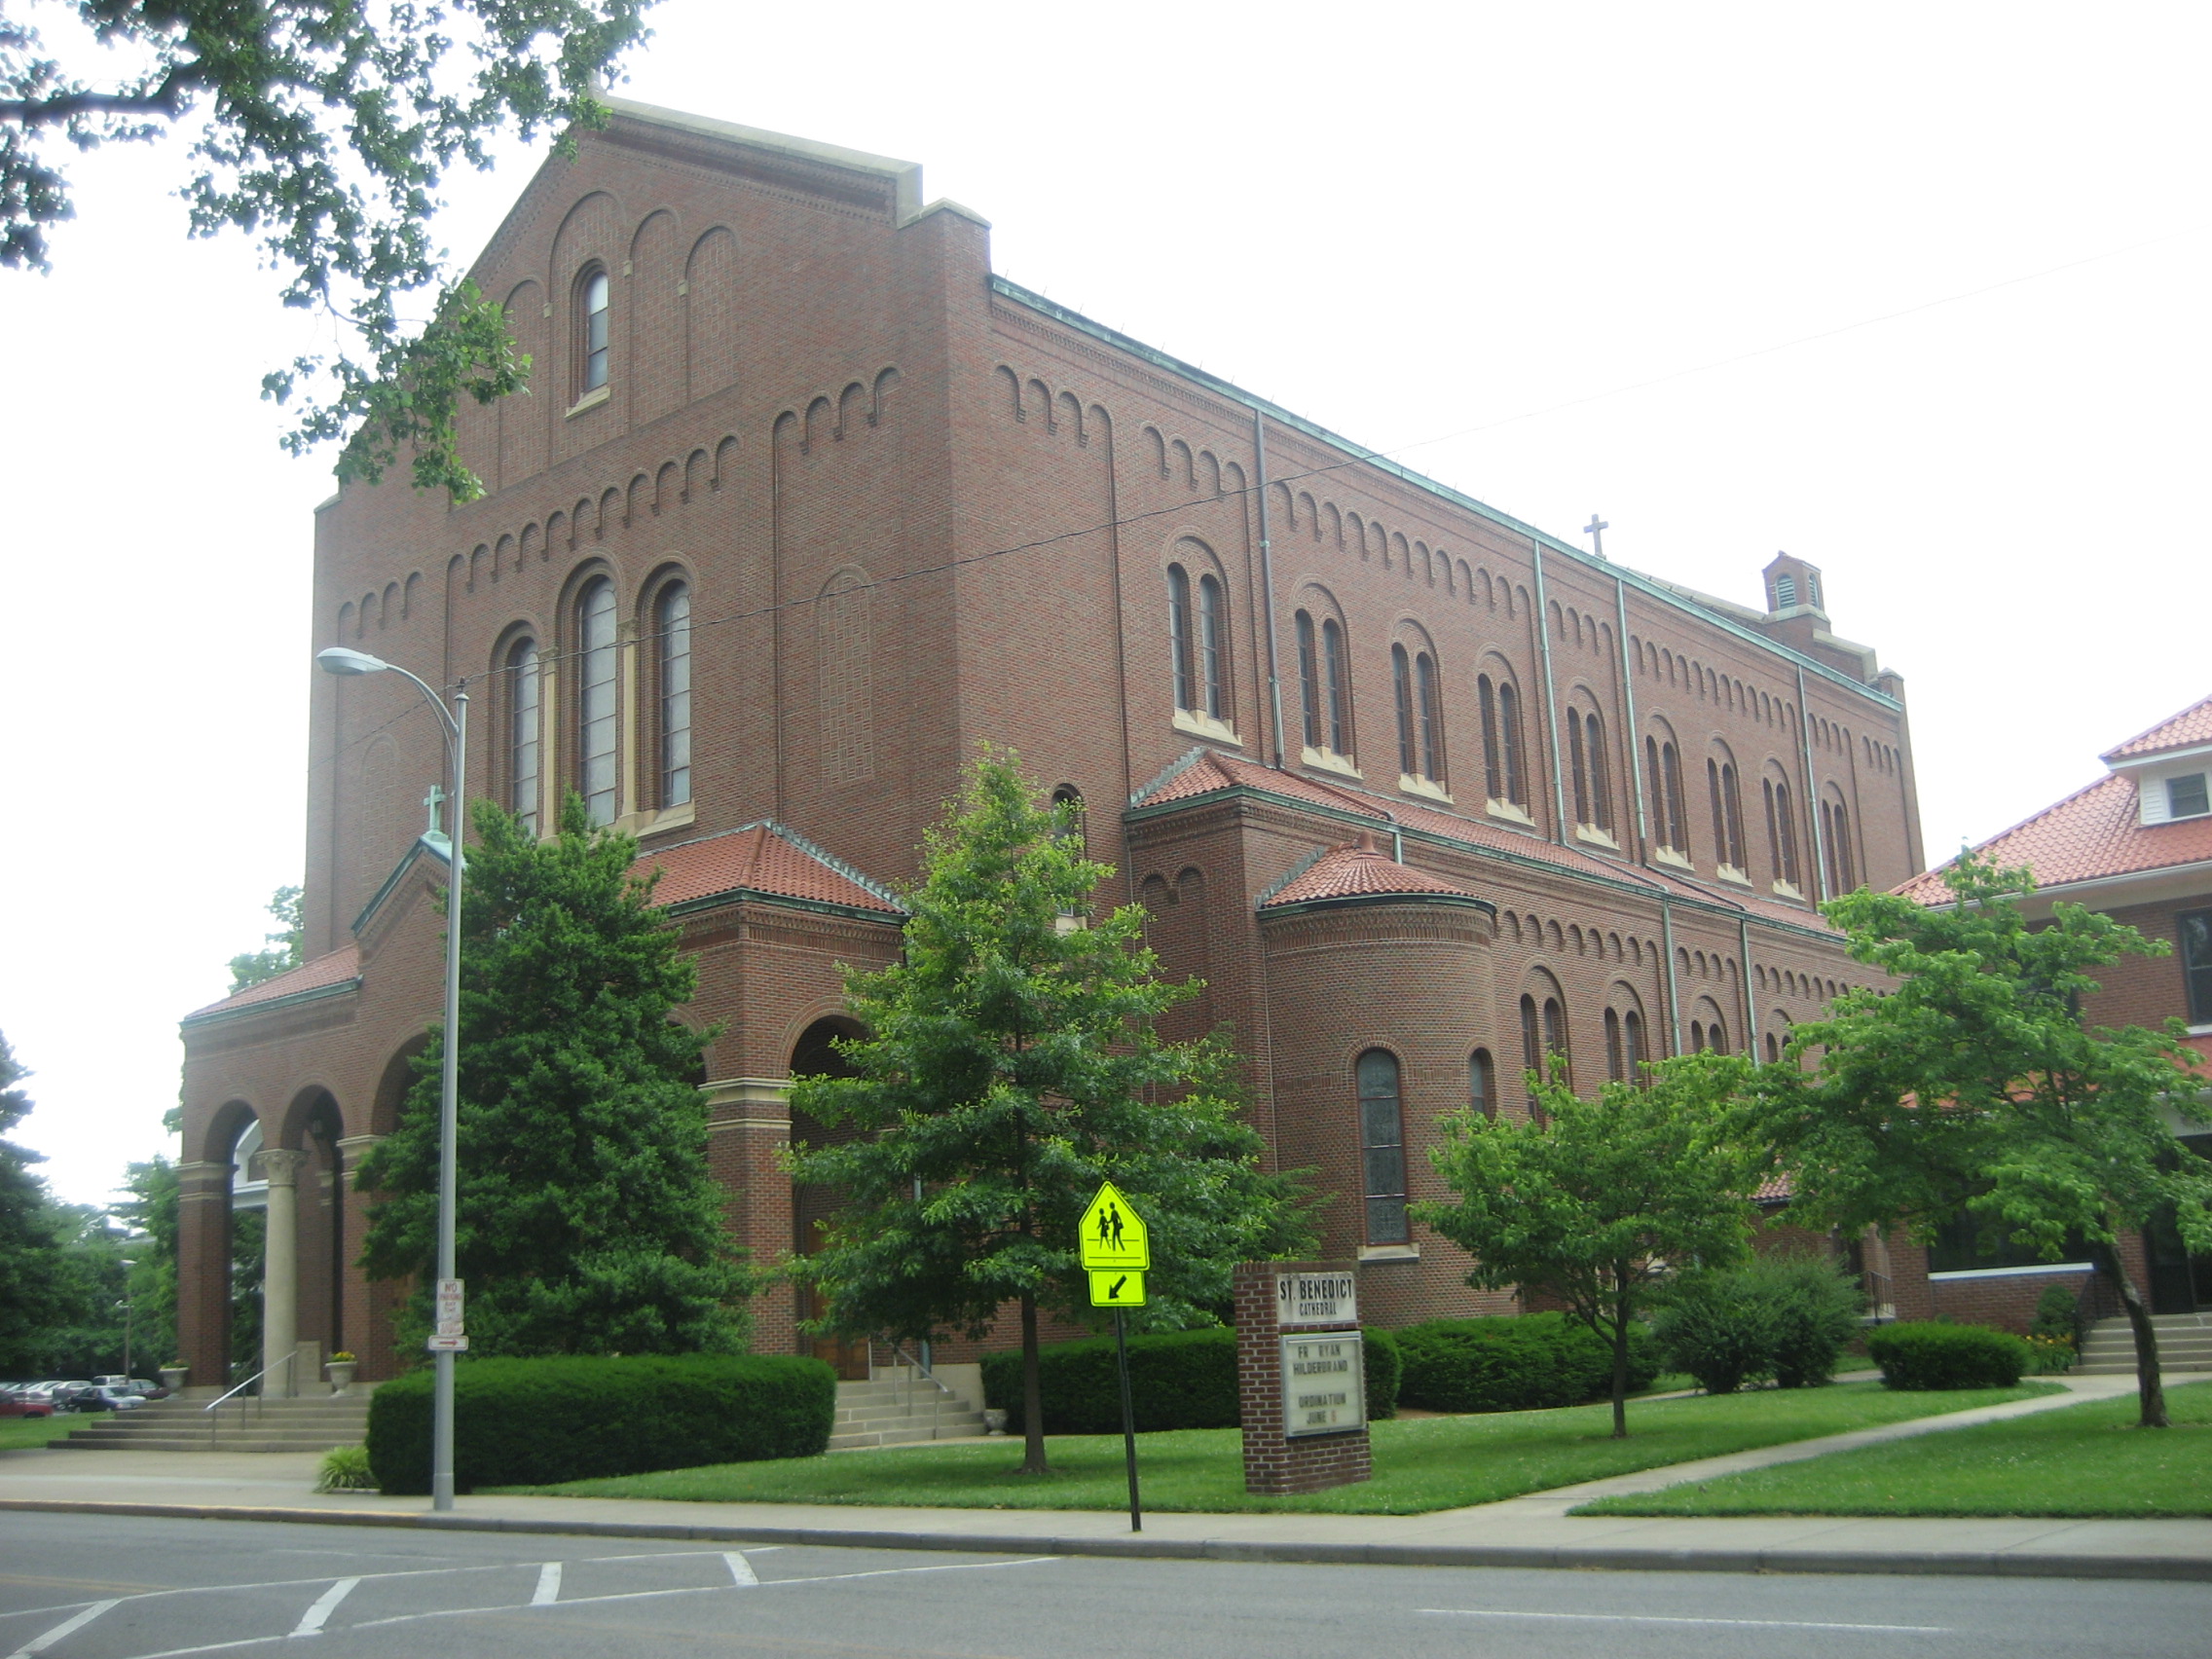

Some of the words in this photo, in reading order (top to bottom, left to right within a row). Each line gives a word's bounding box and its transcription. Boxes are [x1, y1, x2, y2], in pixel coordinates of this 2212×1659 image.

[445, 1282, 458, 1292] NO
[1280, 1280, 1296, 1300] ST.
[1300, 1279, 1352, 1299] BENEDICT
[1300, 1302, 1337, 1316] CATHEDRAL
[1298, 1346, 1309, 1358] FR
[1318, 1345, 1341, 1357] RYAN
[1299, 1393, 1346, 1408] ORDINATION
[1307, 1410, 1326, 1424] JUNE
